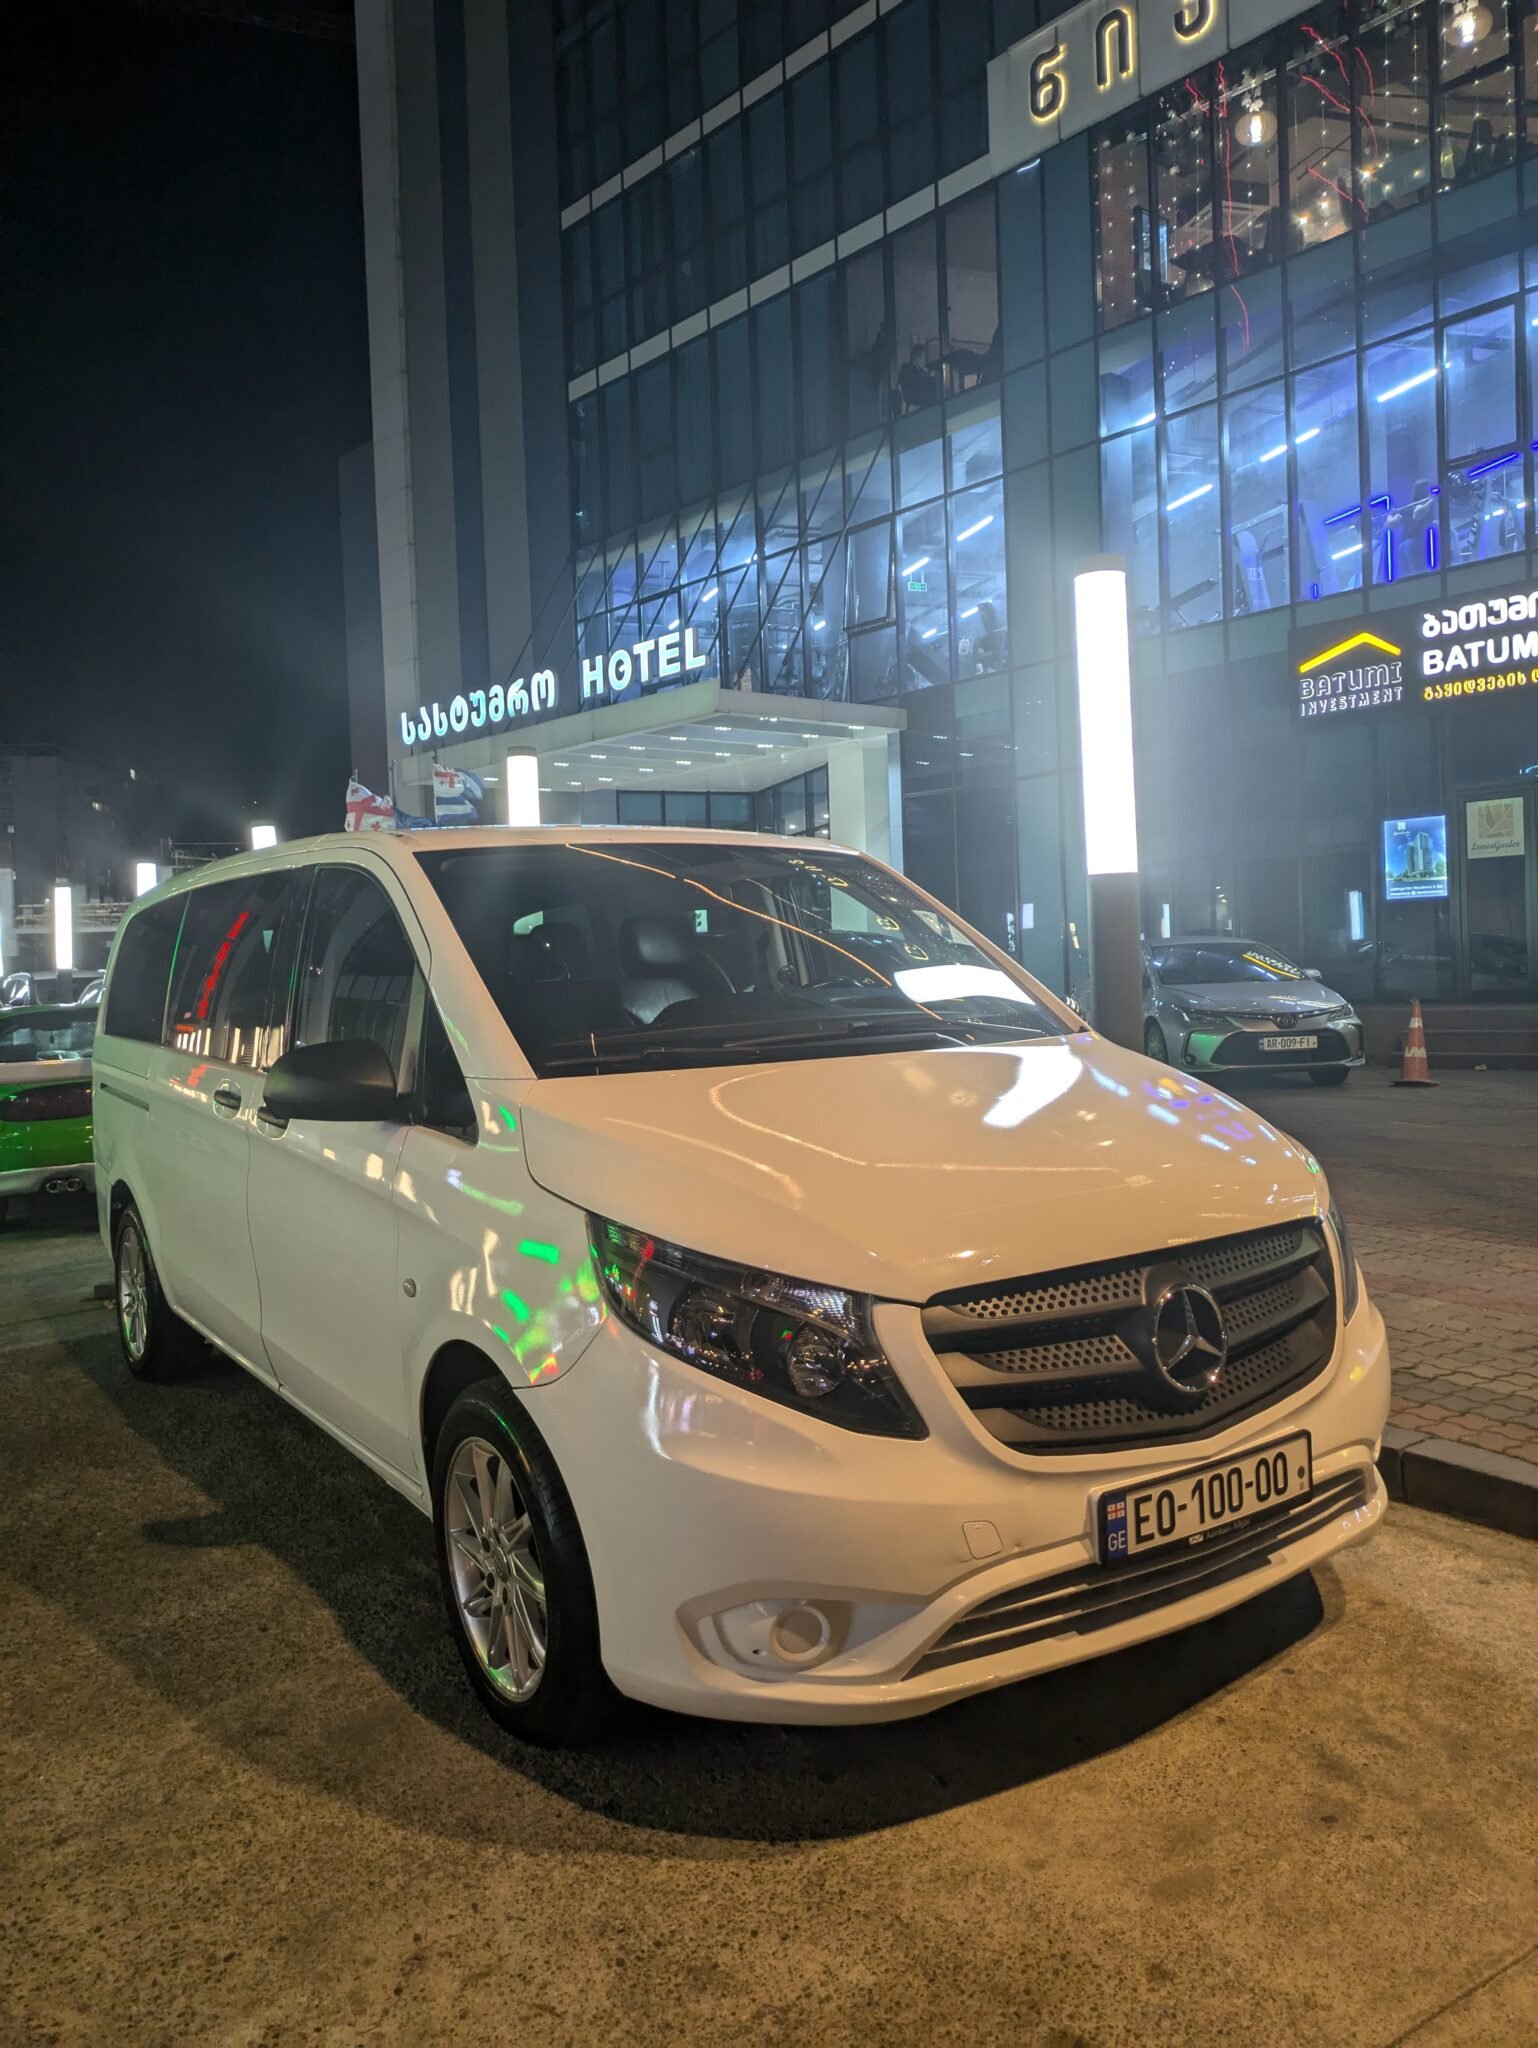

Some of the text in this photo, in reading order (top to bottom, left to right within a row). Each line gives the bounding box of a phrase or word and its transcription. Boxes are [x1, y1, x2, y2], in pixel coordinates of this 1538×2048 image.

[400, 626, 708, 746] სასტუმრო HOTEL
[1300, 661, 1402, 699] BATUMI
[1423, 671, 1527, 701] გაყიდვების
[1300, 686, 1402, 717] INVESTMENT
[1133, 1450, 1289, 1546] EO-100-00
[1107, 1529, 1128, 1552] GE
